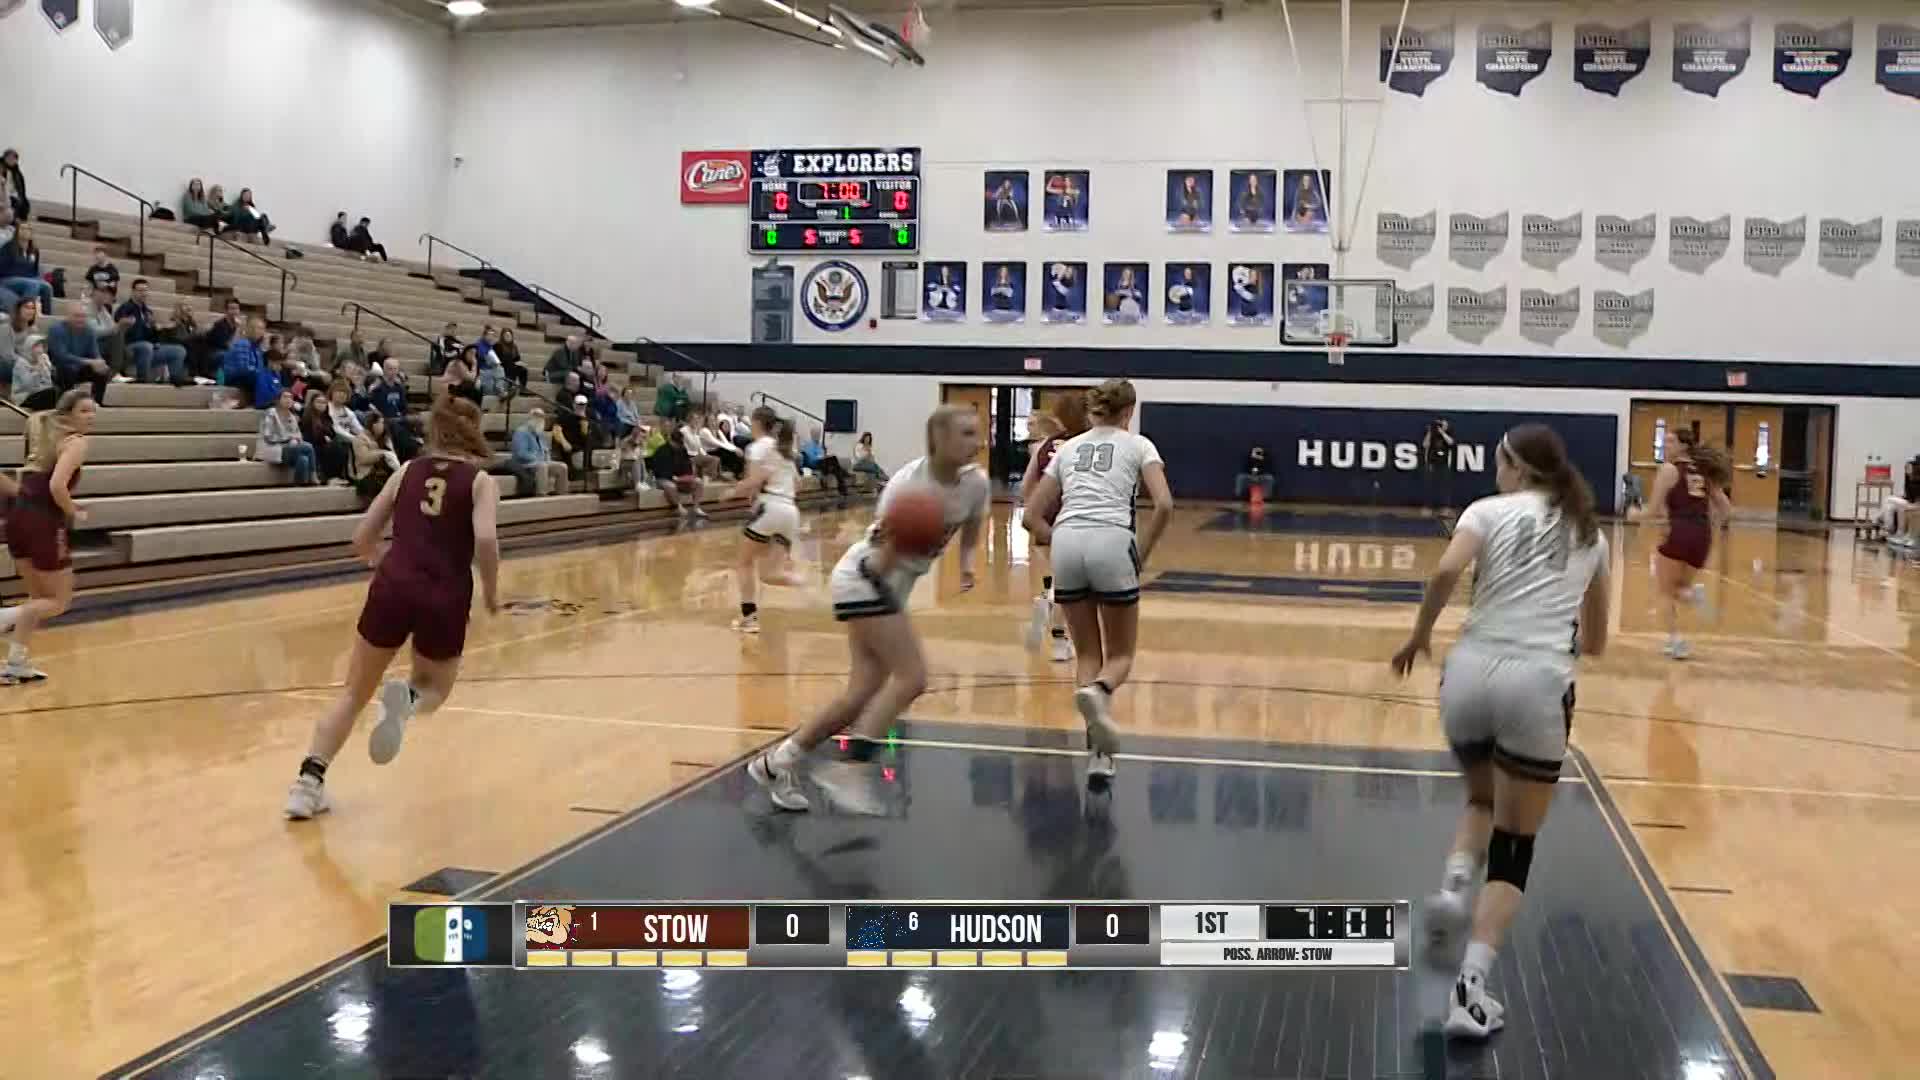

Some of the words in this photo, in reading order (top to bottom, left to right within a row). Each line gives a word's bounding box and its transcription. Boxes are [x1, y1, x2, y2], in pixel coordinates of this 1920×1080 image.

[793, 153, 914, 173] EXPLORERS
[818, 182, 860, 200] 7:00
[894, 191, 908, 210] 0
[775, 192, 788, 211] 0
[766, 230, 778, 245] 0
[896, 229, 910, 245] 0
[1297, 438, 1485, 472] HUDSN
[420, 477, 447, 516] 3
